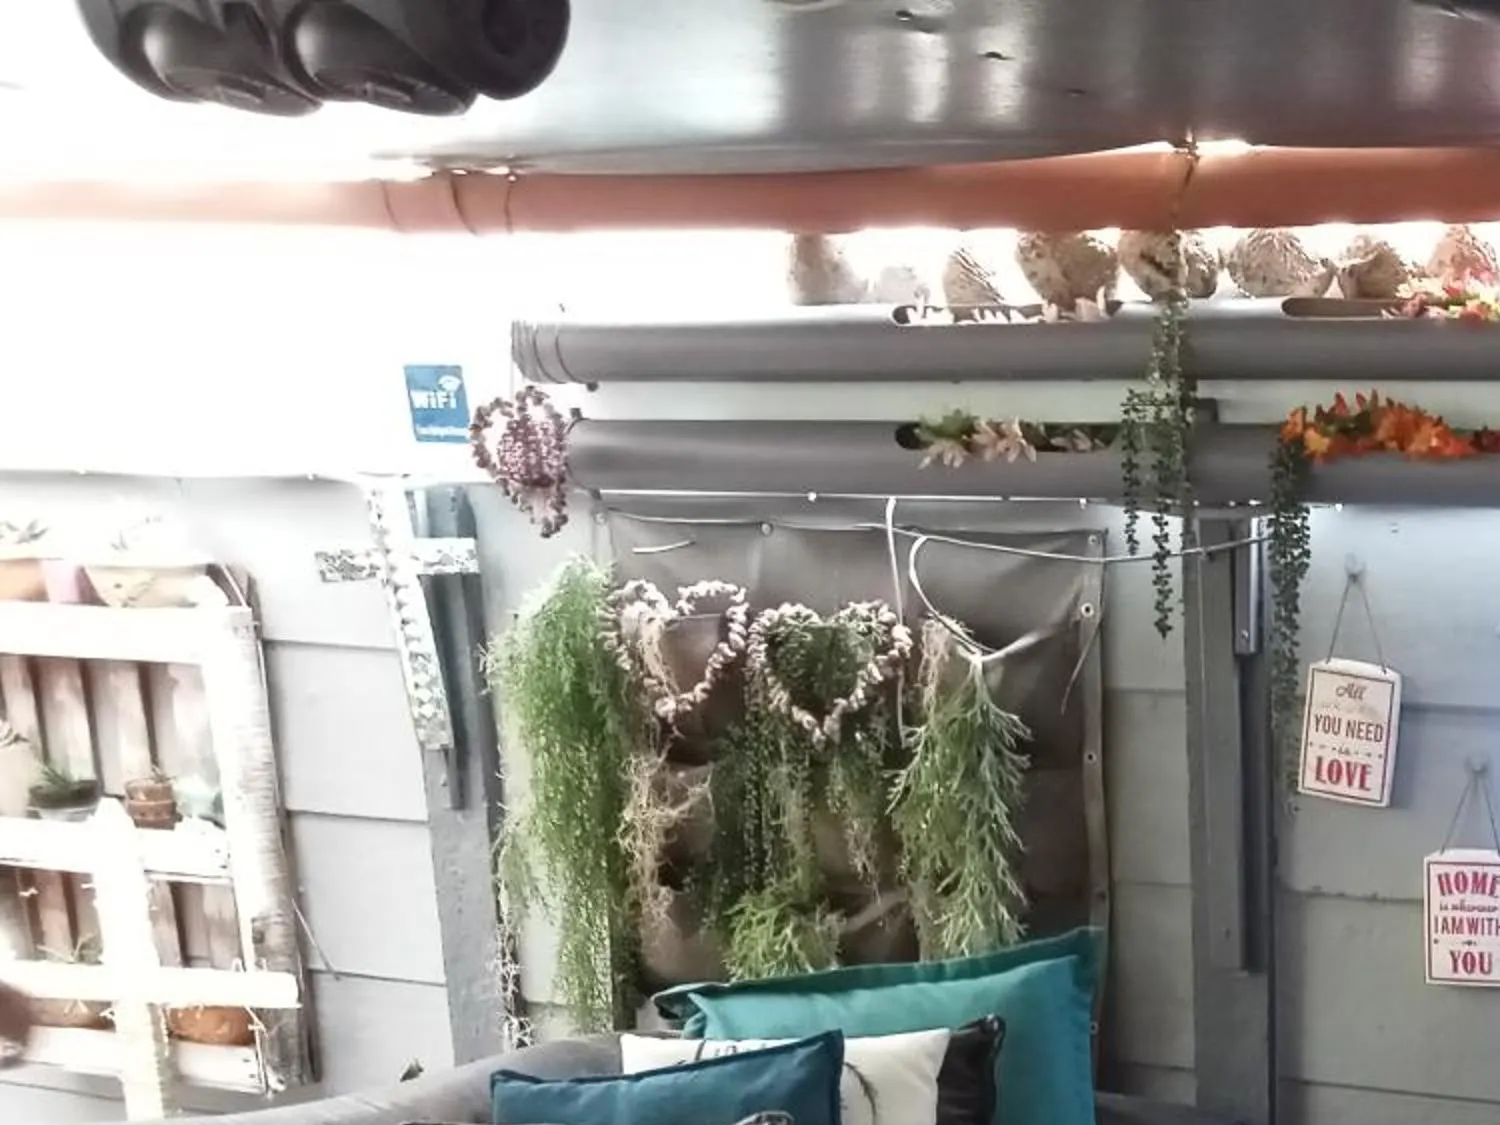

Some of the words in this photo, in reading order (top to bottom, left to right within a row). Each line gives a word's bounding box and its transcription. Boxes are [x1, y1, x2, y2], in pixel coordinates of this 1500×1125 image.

[411, 390, 457, 409] WiFi
[1336, 683, 1367, 699] All
[1314, 714, 1341, 735] YOU
[1345, 720, 1384, 743] NEED
[1315, 757, 1372, 790] LOVE
[1434, 915, 1439, 934] I
[1442, 916, 1465, 935] AM
[1449, 951, 1493, 975] YOU
